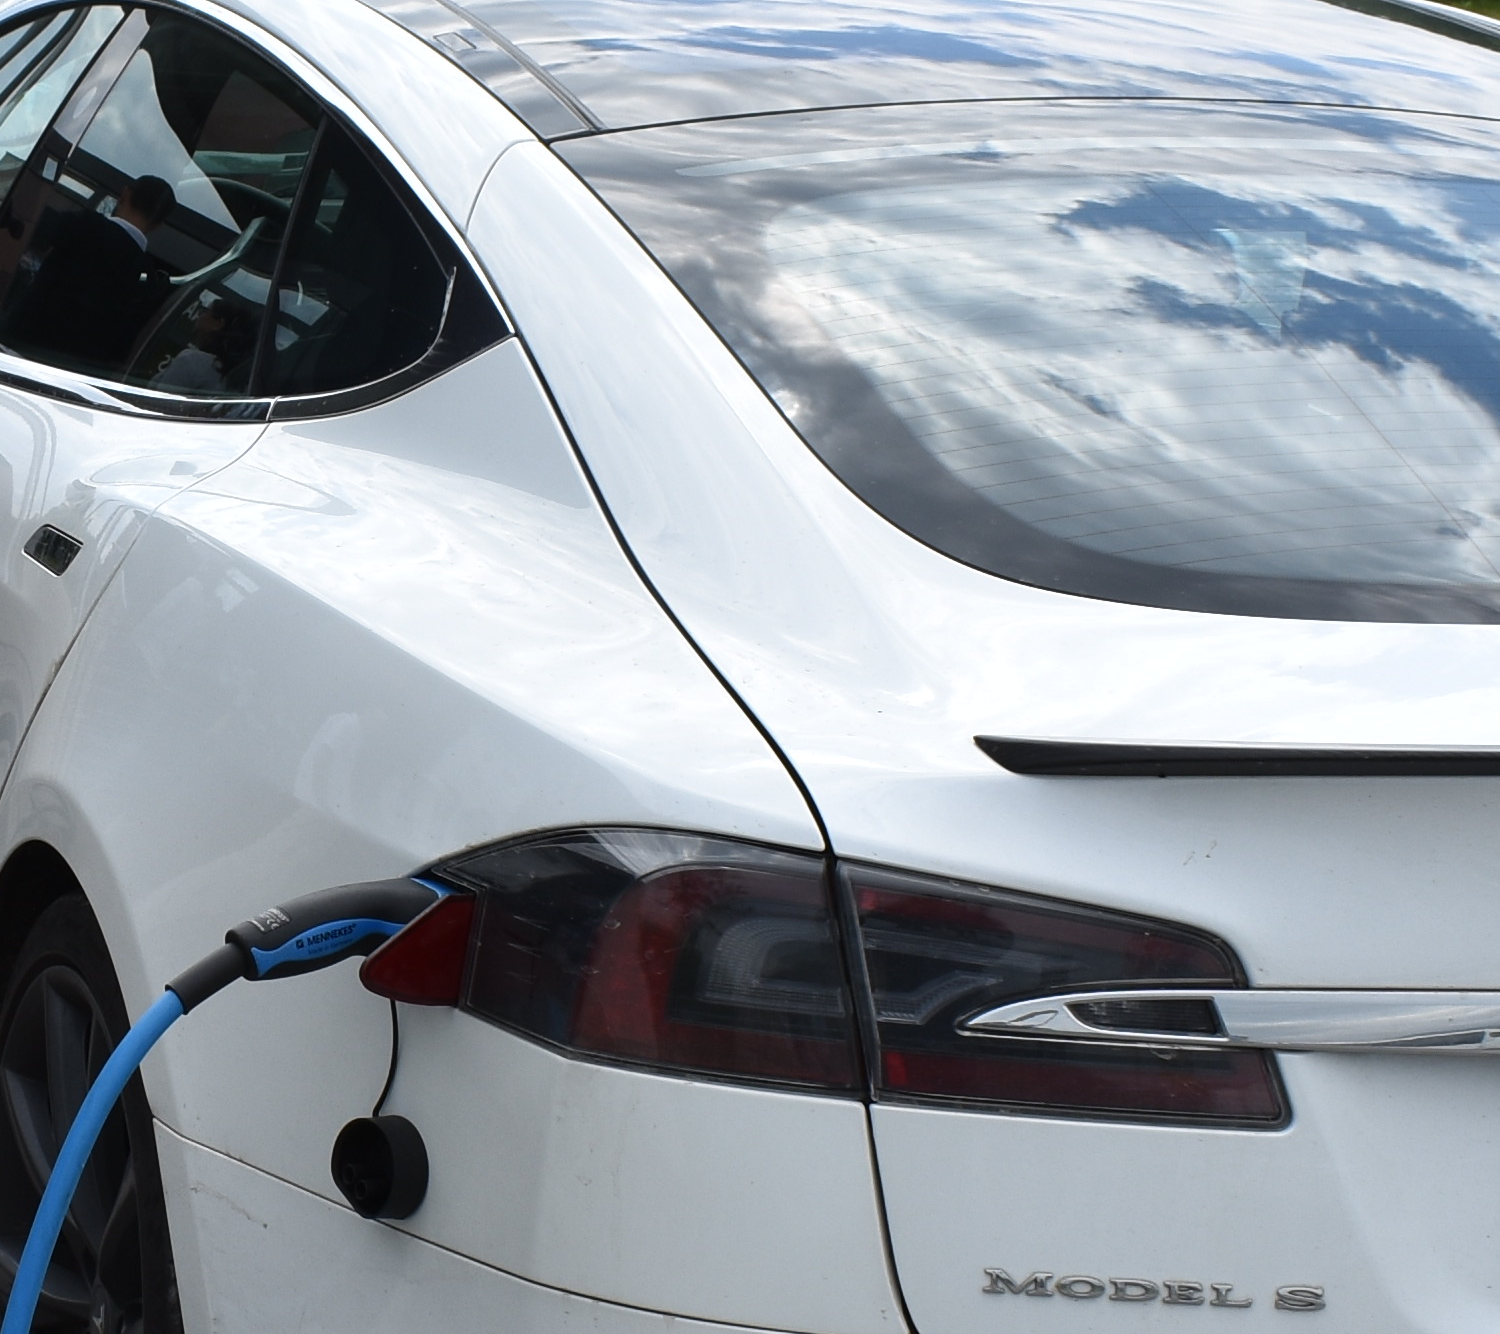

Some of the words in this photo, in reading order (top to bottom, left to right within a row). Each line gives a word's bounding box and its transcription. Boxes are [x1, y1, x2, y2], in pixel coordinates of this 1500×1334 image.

[306, 923, 357, 946] MENNEKES
[982, 1267, 1253, 1308] MODEL
[1274, 1284, 1326, 1312] S
